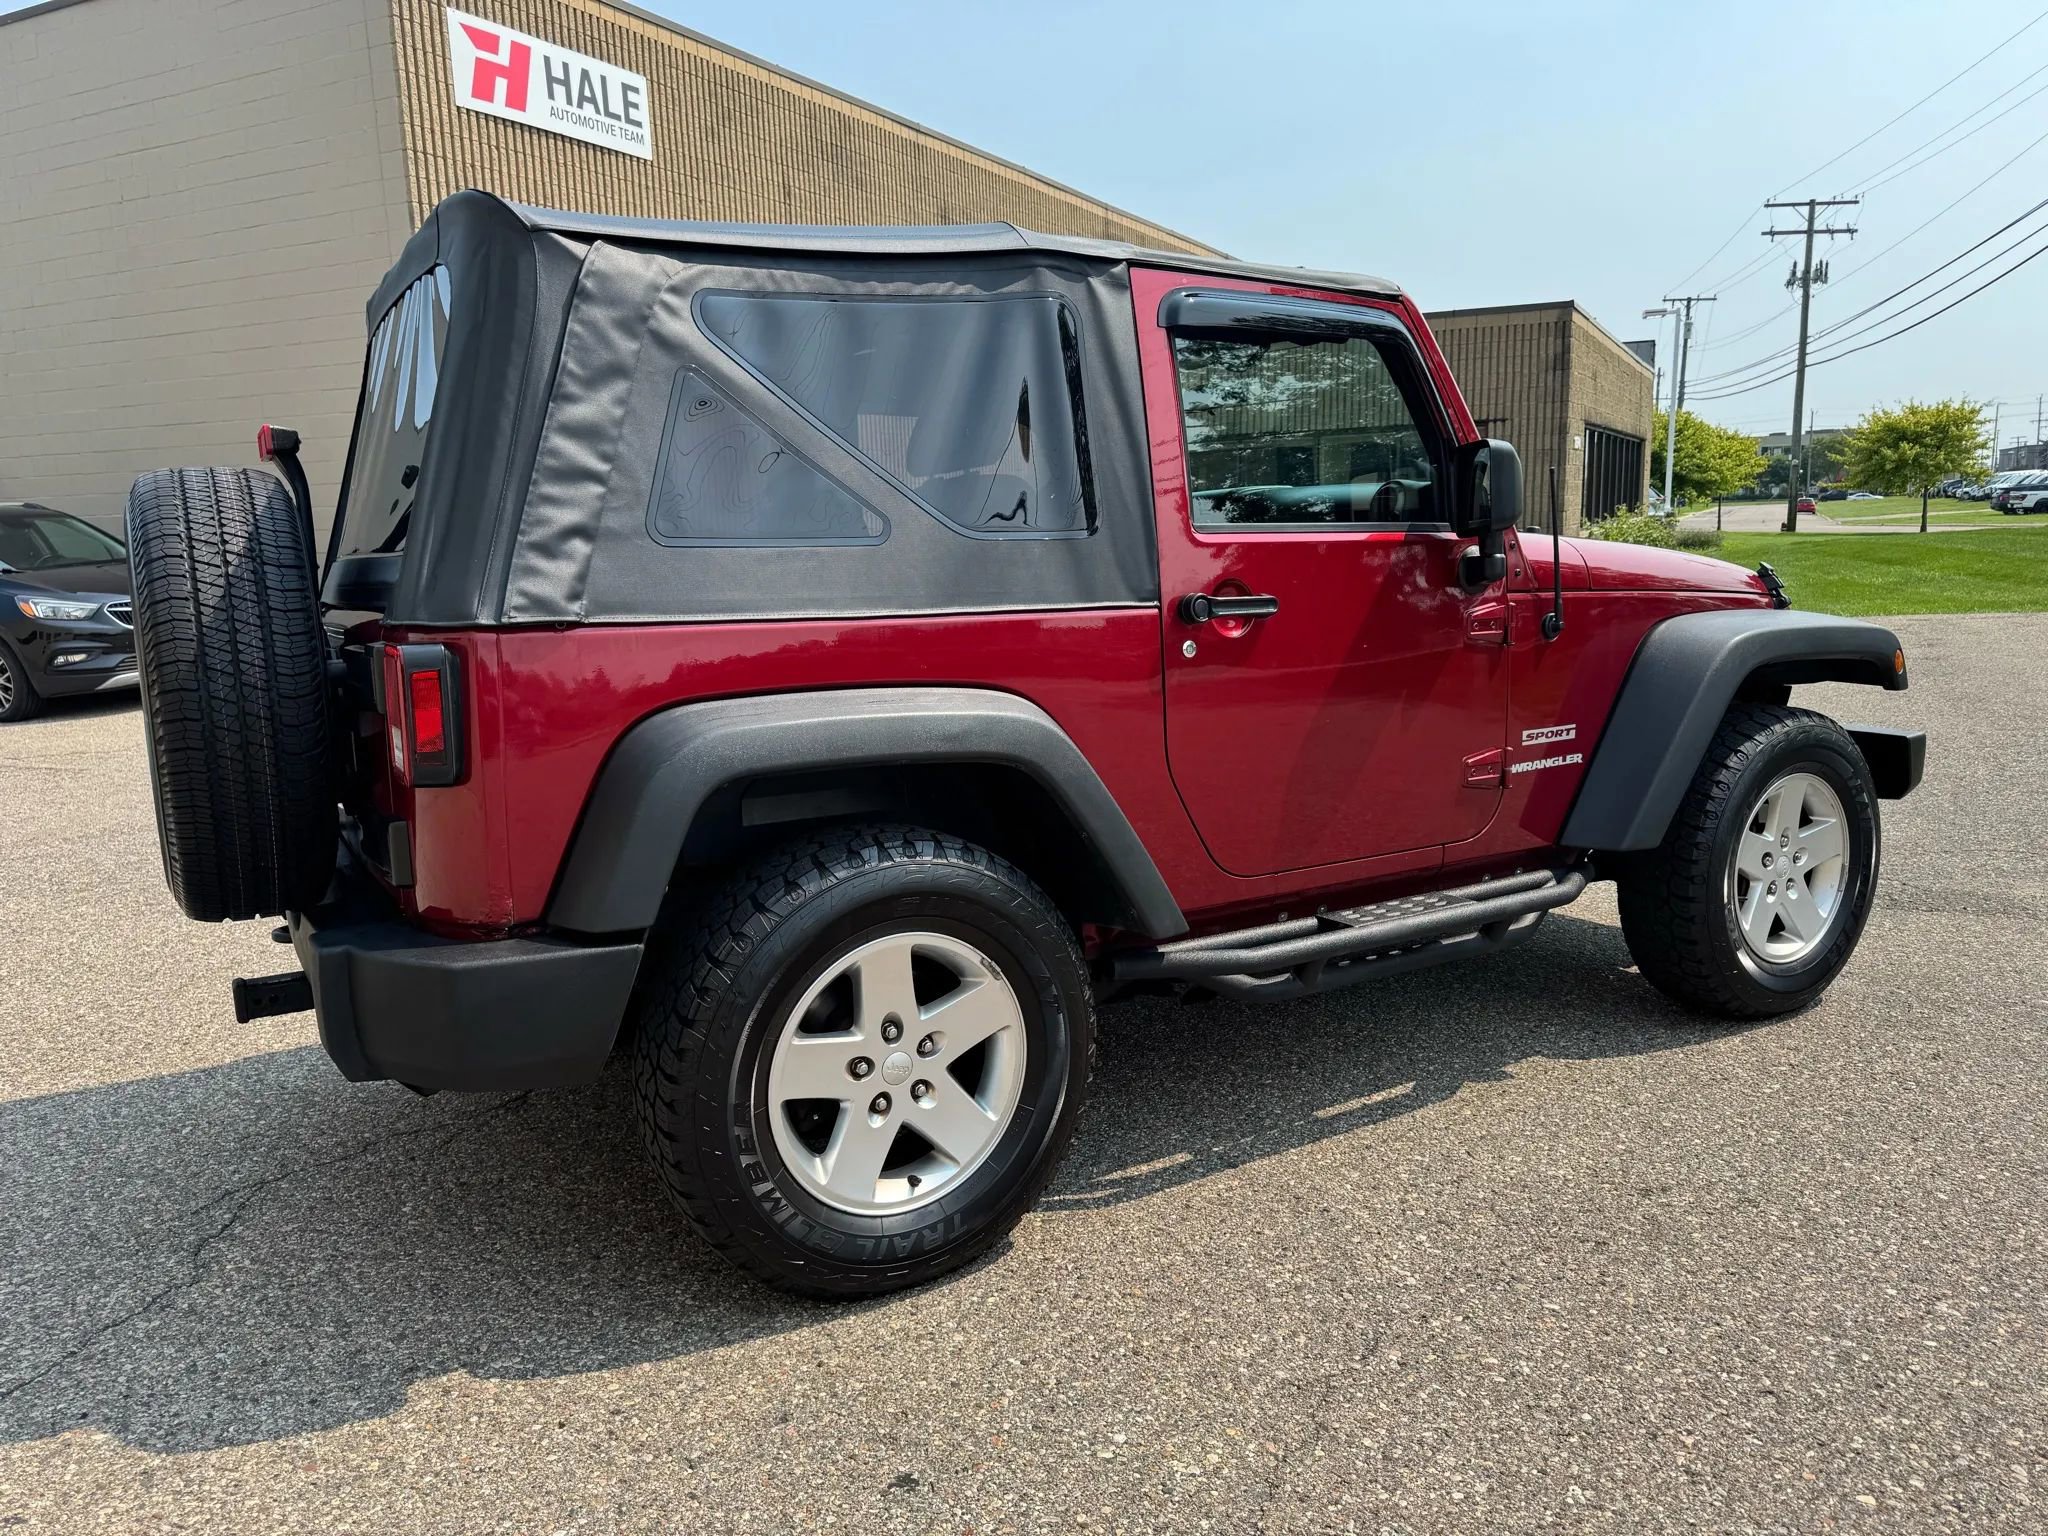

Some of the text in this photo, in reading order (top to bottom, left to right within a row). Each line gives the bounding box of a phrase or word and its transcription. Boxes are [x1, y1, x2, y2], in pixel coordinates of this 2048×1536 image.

[543, 54, 643, 129] HALE
[549, 105, 645, 146] AUTOMOTIVE TEAM
[1524, 727, 1575, 742] SPORT
[1511, 753, 1583, 773] WRANGLER
[856, 1213, 968, 1260] TRAIL
